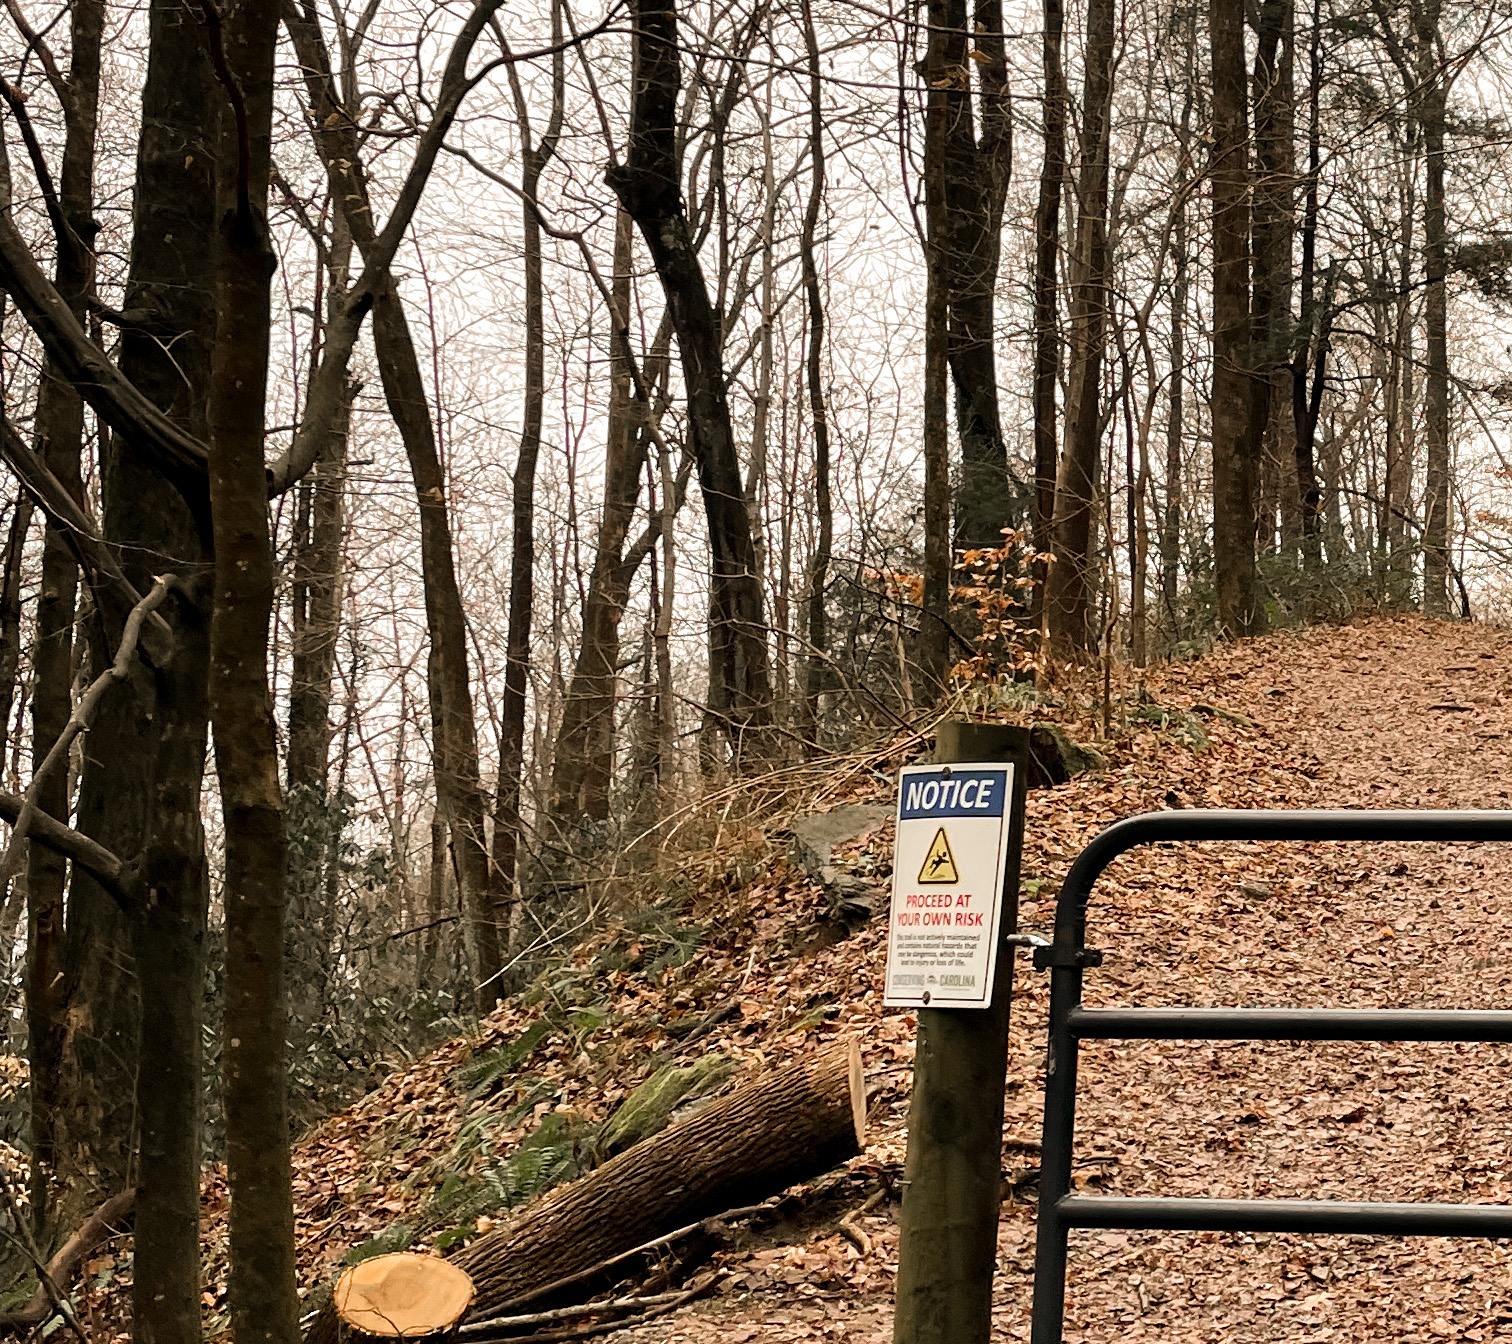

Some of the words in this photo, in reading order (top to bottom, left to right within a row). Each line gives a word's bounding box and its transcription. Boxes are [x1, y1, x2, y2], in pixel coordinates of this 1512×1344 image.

[905, 779, 995, 811] NOTICE
[906, 894, 952, 908] PROCEED
[955, 894, 972, 908] AT
[897, 912, 920, 926] YOUR
[922, 912, 952, 926] OWN
[955, 912, 984, 926] RISK
[939, 974, 976, 987] CAROLINA
